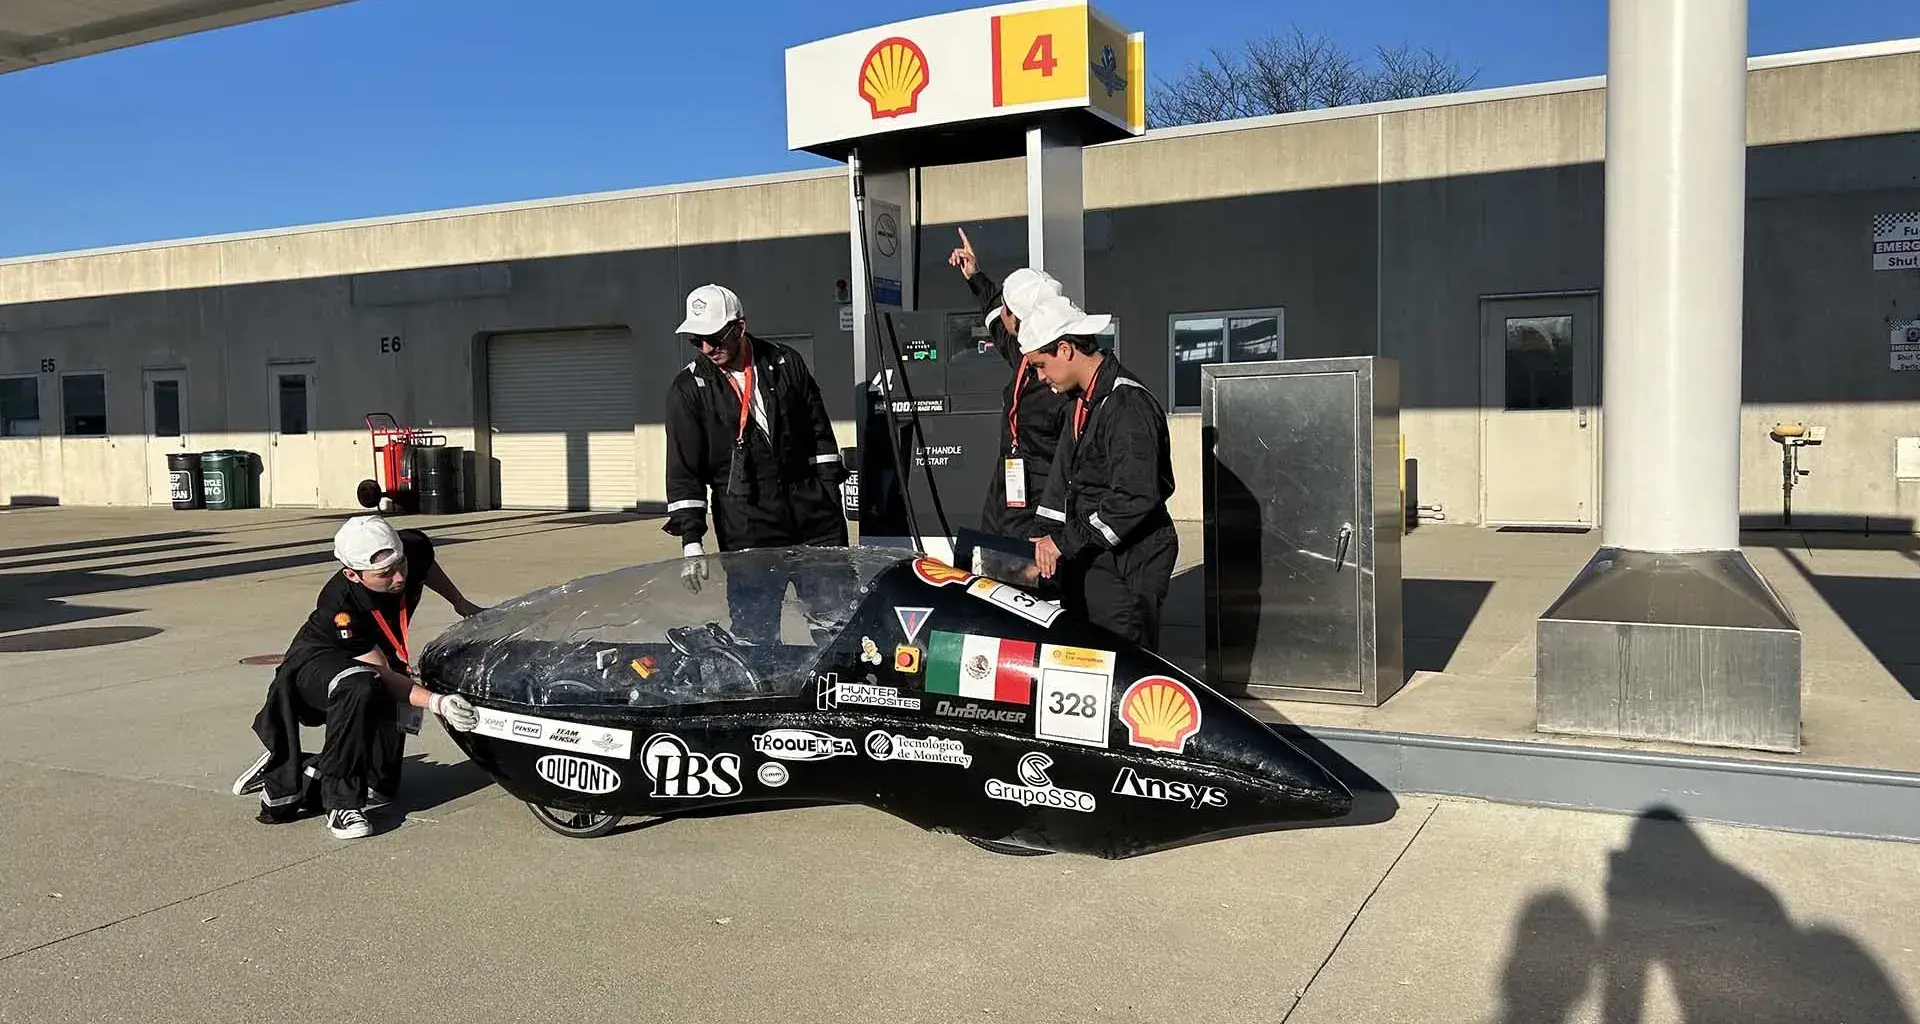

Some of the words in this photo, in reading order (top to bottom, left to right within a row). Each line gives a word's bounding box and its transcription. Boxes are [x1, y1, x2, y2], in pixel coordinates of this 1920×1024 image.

[1022, 34, 1058, 77] 4
[1888, 256, 1918, 266] Shut
[381, 336, 401, 353] E6
[41, 358, 56, 372] E5
[931, 445, 962, 455] HANDLE
[841, 684, 897, 698] HUNTER
[840, 694, 920, 709] COMPOSITES
[1048, 690, 1097, 719] 328
[514, 725, 540, 735] PENSKE
[556, 728, 580, 737] TEAM
[549, 734, 582, 745] PENSKE
[898, 736, 962, 751] Tecnológico
[897, 749, 906, 759] de
[907, 750, 972, 768] Monterrey
[546, 758, 611, 791] DUPONT
[1113, 767, 1228, 809] Ansys
[986, 780, 1094, 812] GrupoSSC
